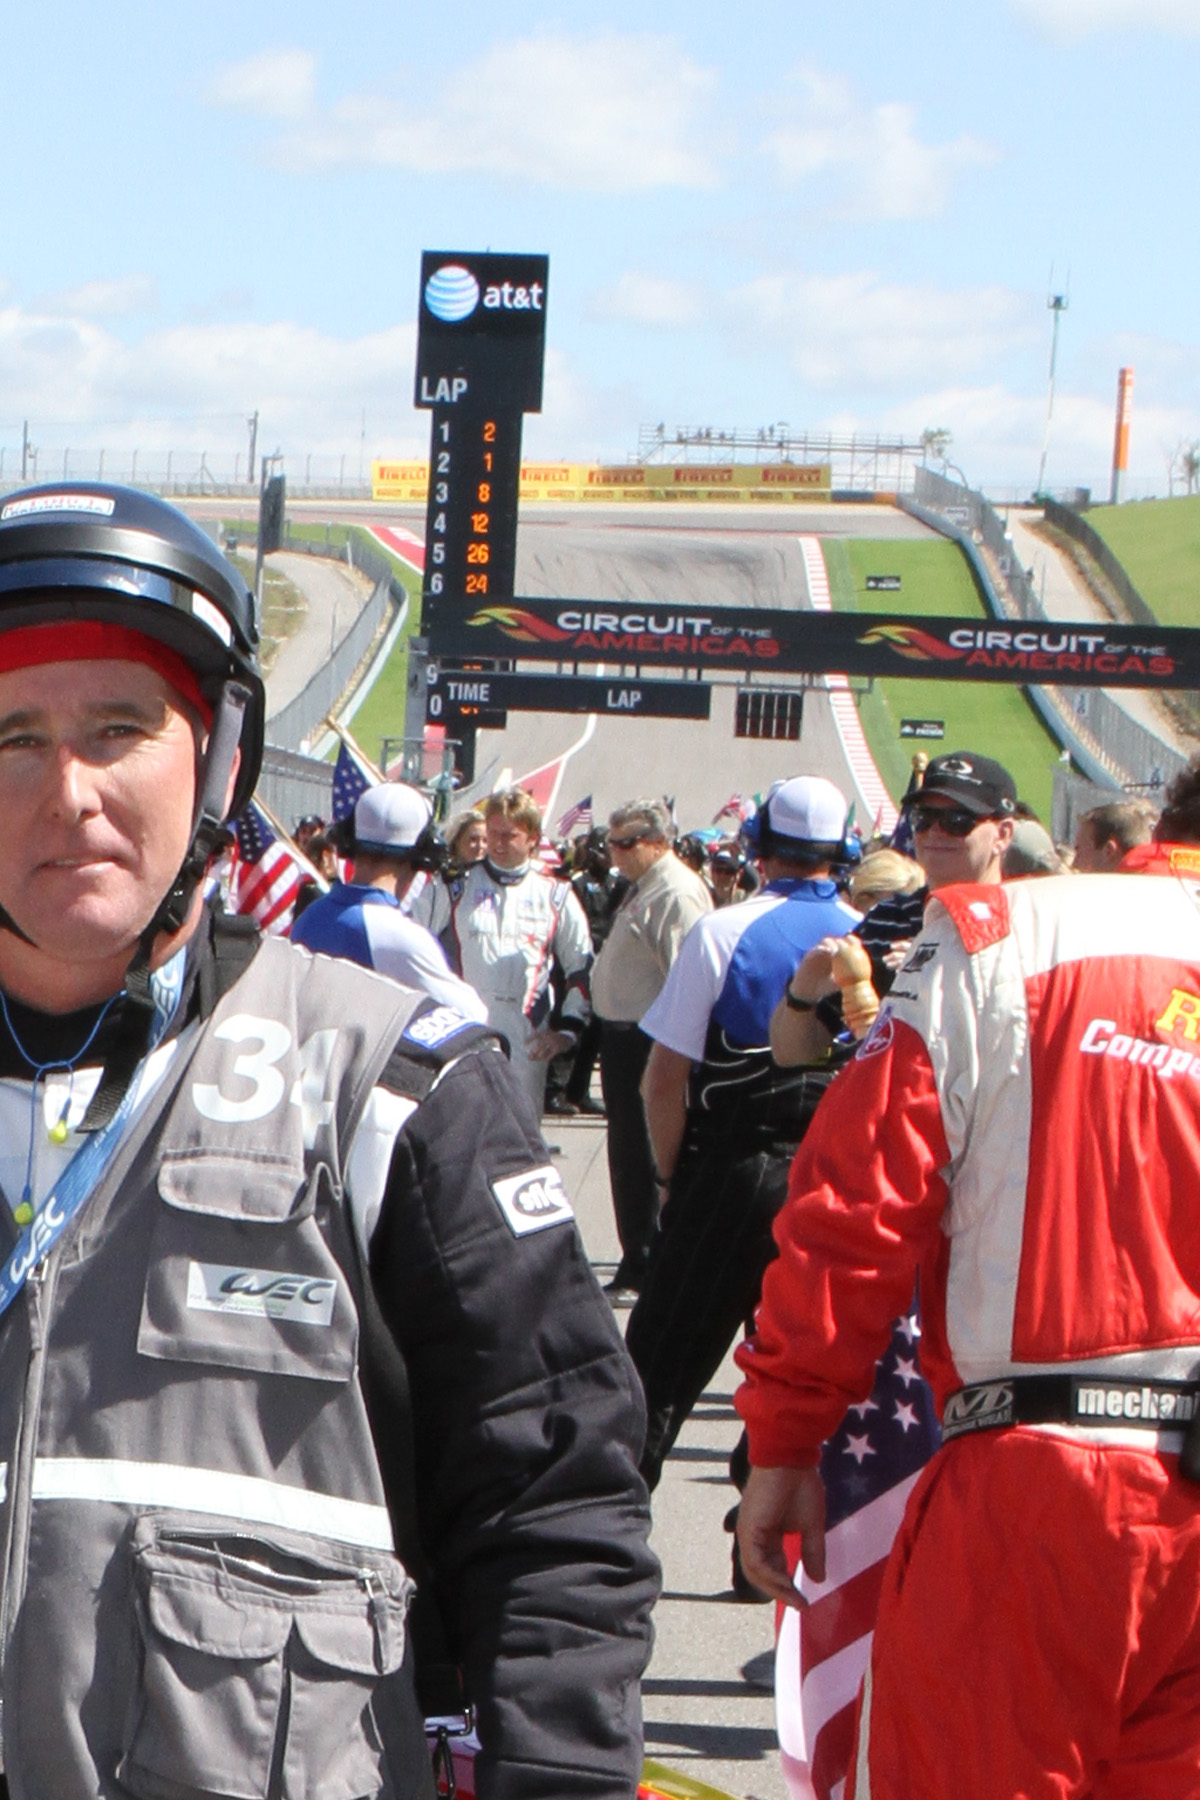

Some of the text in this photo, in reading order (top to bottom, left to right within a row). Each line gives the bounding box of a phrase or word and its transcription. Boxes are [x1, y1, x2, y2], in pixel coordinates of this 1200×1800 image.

[483, 282, 543, 309] at&t
[421, 377, 468, 402] LAP
[440, 421, 496, 443] 1 2
[437, 452, 492, 473] 2 1
[436, 482, 448, 503] 3
[478, 483, 491, 503] 8
[434, 513, 489, 533] 4 12
[433, 543, 490, 564] 5 26
[431, 573, 487, 594] 6 24
[557, 611, 772, 639] CIRCUIT OF THE
[573, 631, 781, 658] AMERICAS
[950, 628, 1166, 656] CIRCUIT OF THE
[965, 650, 1175, 677] AMERICAS
[447, 682, 490, 702] TIME
[607, 689, 642, 709] LAP
[10, 1197, 64, 1284] WEC
[220, 1272, 334, 1304] WEC
